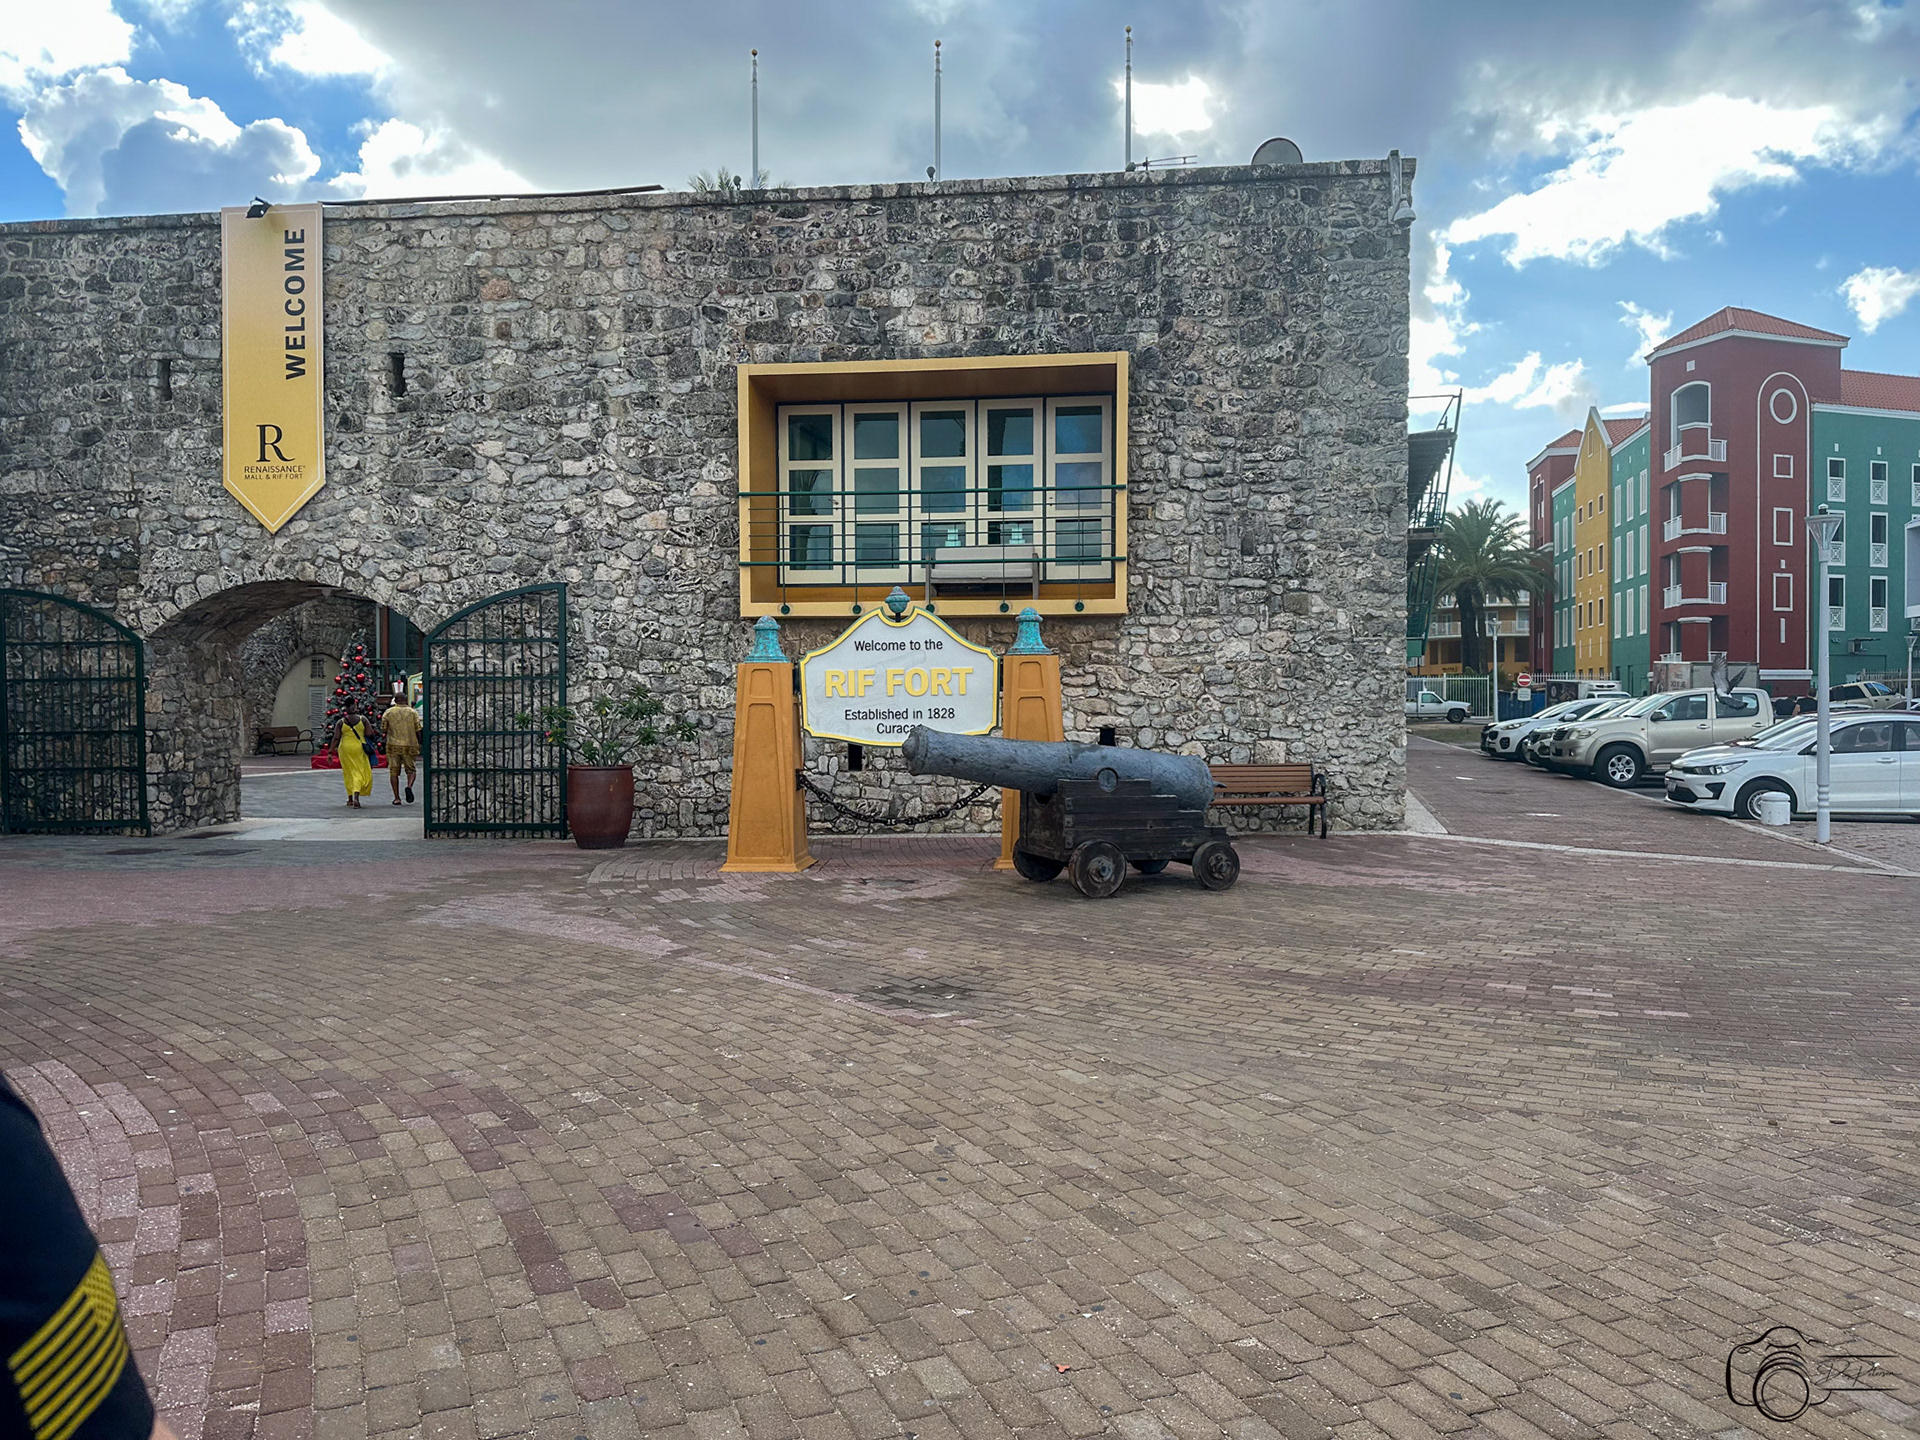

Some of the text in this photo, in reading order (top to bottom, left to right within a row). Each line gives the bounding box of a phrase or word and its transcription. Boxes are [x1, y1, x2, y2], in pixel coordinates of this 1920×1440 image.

[284, 228, 306, 381] WELCOME
[256, 424, 296, 463] R
[854, 639, 943, 651] Welcome to the
[825, 666, 974, 698] RIF FORT
[844, 707, 955, 721] Established in 1828
[876, 722, 922, 735] Curaça
